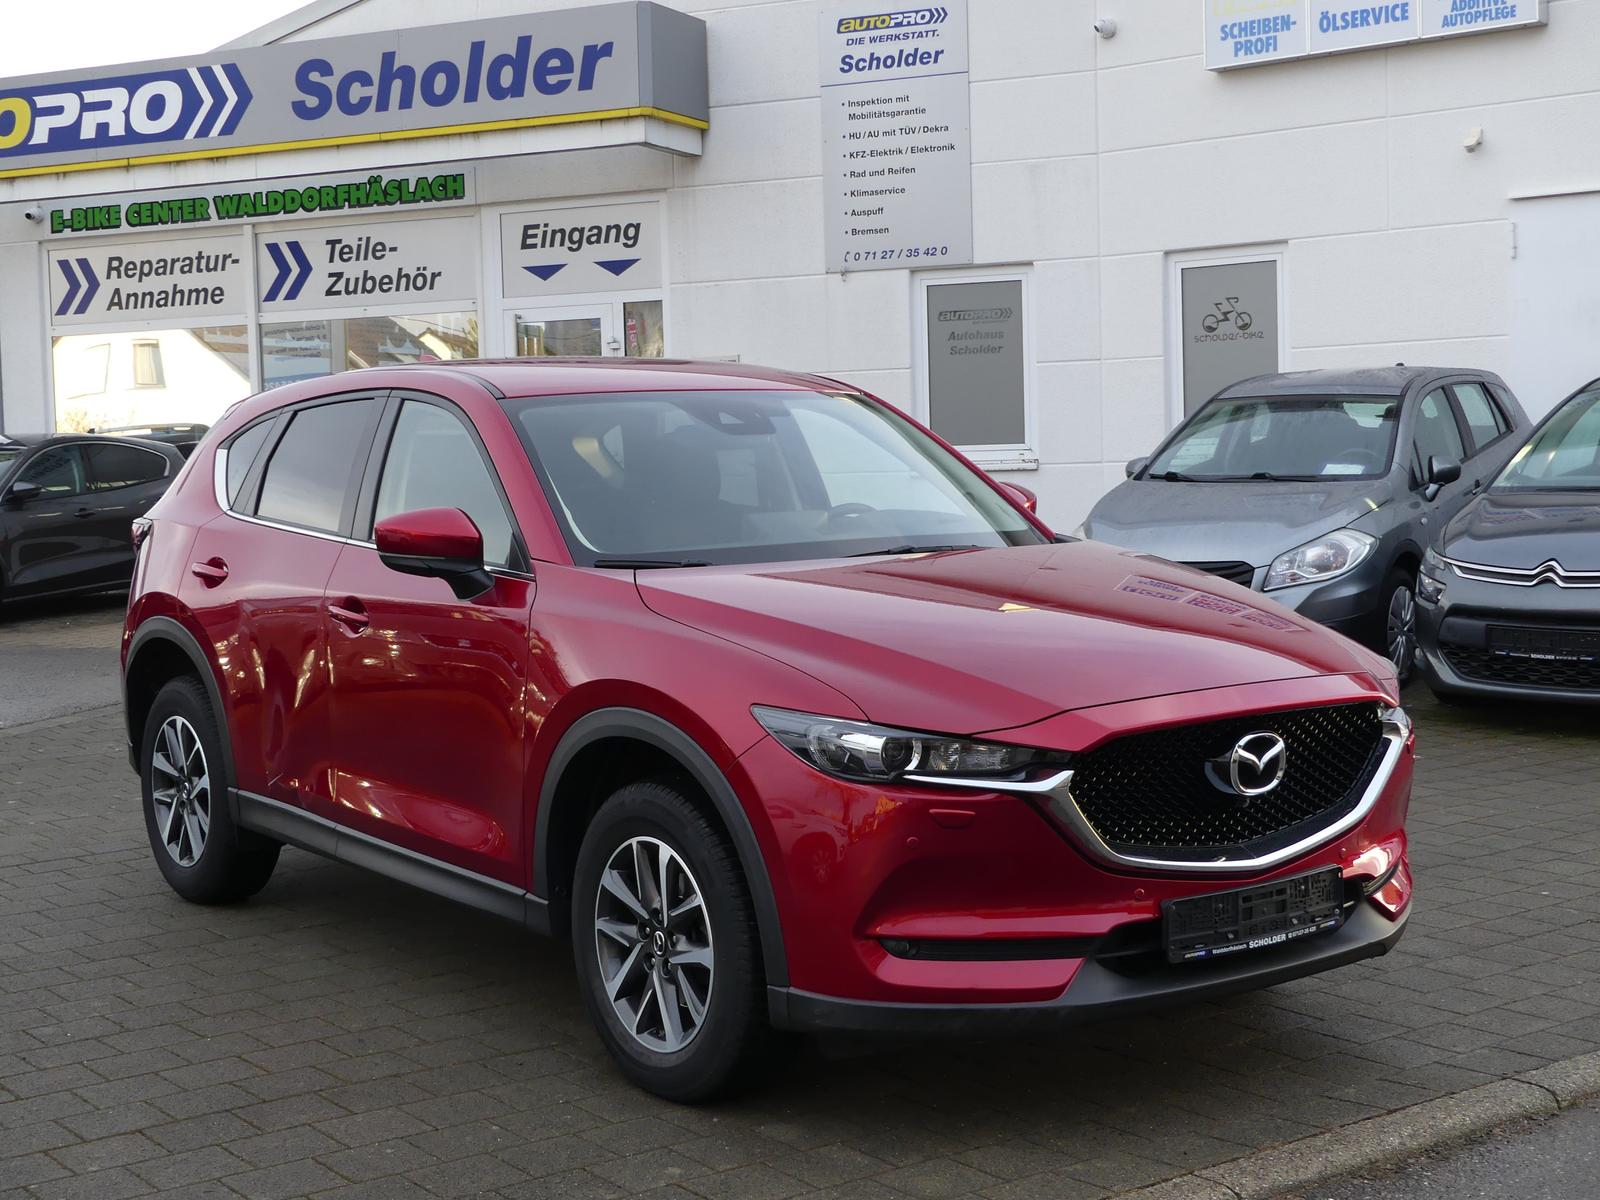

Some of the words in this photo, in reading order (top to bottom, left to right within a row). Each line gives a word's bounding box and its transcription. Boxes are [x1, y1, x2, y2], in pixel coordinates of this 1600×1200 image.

[1319, 3, 1409, 34] ÖLSERVICE
[1441, 5, 1516, 28] AUTOPFLEGE
[846, 37, 865, 46] DIE
[868, 29, 940, 44] WERKSTATT.
[1220, 14, 1297, 41] SCHEIBEN-
[1233, 35, 1278, 58] PROFI
[839, 48, 945, 74] Scholder
[291, 36, 613, 120] Scholder
[848, 97, 893, 108] Inspektion
[895, 95, 910, 104] mit
[848, 107, 927, 121] Mobilitätsgarantie
[882, 129, 896, 137] mit
[849, 170, 866, 179] Rad
[869, 169, 886, 177] und
[888, 166, 916, 175] Reifen
[850, 187, 906, 198] Klimaservice
[51, 204, 121, 233] E-BIKE
[125, 197, 211, 226] CENTER
[212, 174, 464, 217] WALDDORFHÄSLACH
[850, 207, 884, 217] Auspuff
[520, 222, 642, 253] Eingang
[851, 227, 889, 236] Bremsen
[323, 236, 398, 263] Teile-
[853, 252, 861, 261] 0
[864, 251, 877, 261] 71
[881, 250, 895, 260] 27
[906, 248, 920, 258] 35
[923, 247, 937, 256] 42
[940, 246, 948, 256] 0
[105, 251, 239, 282] Reparatur-
[323, 269, 442, 298] Zubehör
[105, 284, 225, 312] Annahme
[947, 331, 1004, 341] Autohaus
[949, 345, 1004, 355] Scholder
[1248, 934, 1286, 949] SCHOLDER
